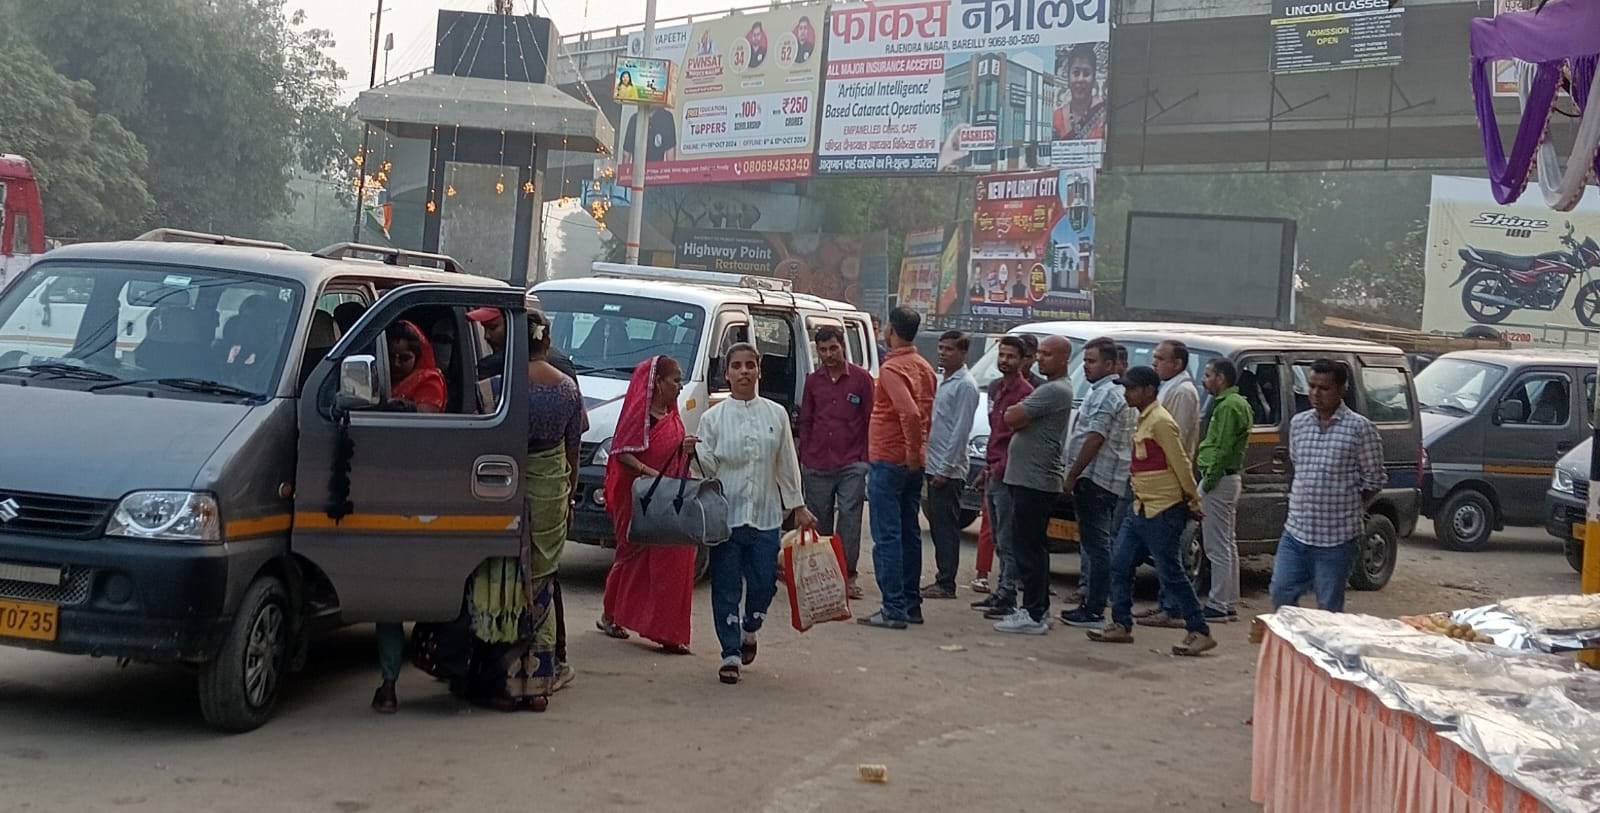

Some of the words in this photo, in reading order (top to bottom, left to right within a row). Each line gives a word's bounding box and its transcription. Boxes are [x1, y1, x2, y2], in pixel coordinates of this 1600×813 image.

[1285, 2, 1333, 16] LINCOLN
[1335, 0, 1389, 11] CLASSES
[655, 31, 687, 45] YAPEETH
[1306, 26, 1350, 38] ADMISSION
[885, 43, 921, 54] RAJENDRA
[952, 37, 986, 50] BAREILLY
[1316, 37, 1339, 46] OPEN
[735, 51, 744, 66] 34
[781, 48, 792, 61] 52
[827, 64, 839, 76] ALL
[841, 62, 865, 75] MAJOR
[866, 60, 905, 73] INSURANCE
[906, 58, 942, 71] ACCEPTED
[825, 102, 851, 118] Based
[852, 102, 889, 118] Cataract
[891, 100, 941, 119] Operations
[690, 122, 727, 136] TOPPERS
[987, 181, 1006, 200] NEW
[1040, 177, 1058, 197] CITY
[1470, 212, 1549, 229] Shine
[683, 242, 737, 260] Highway
[740, 245, 772, 260] Point
[715, 258, 770, 272] Restaurant
